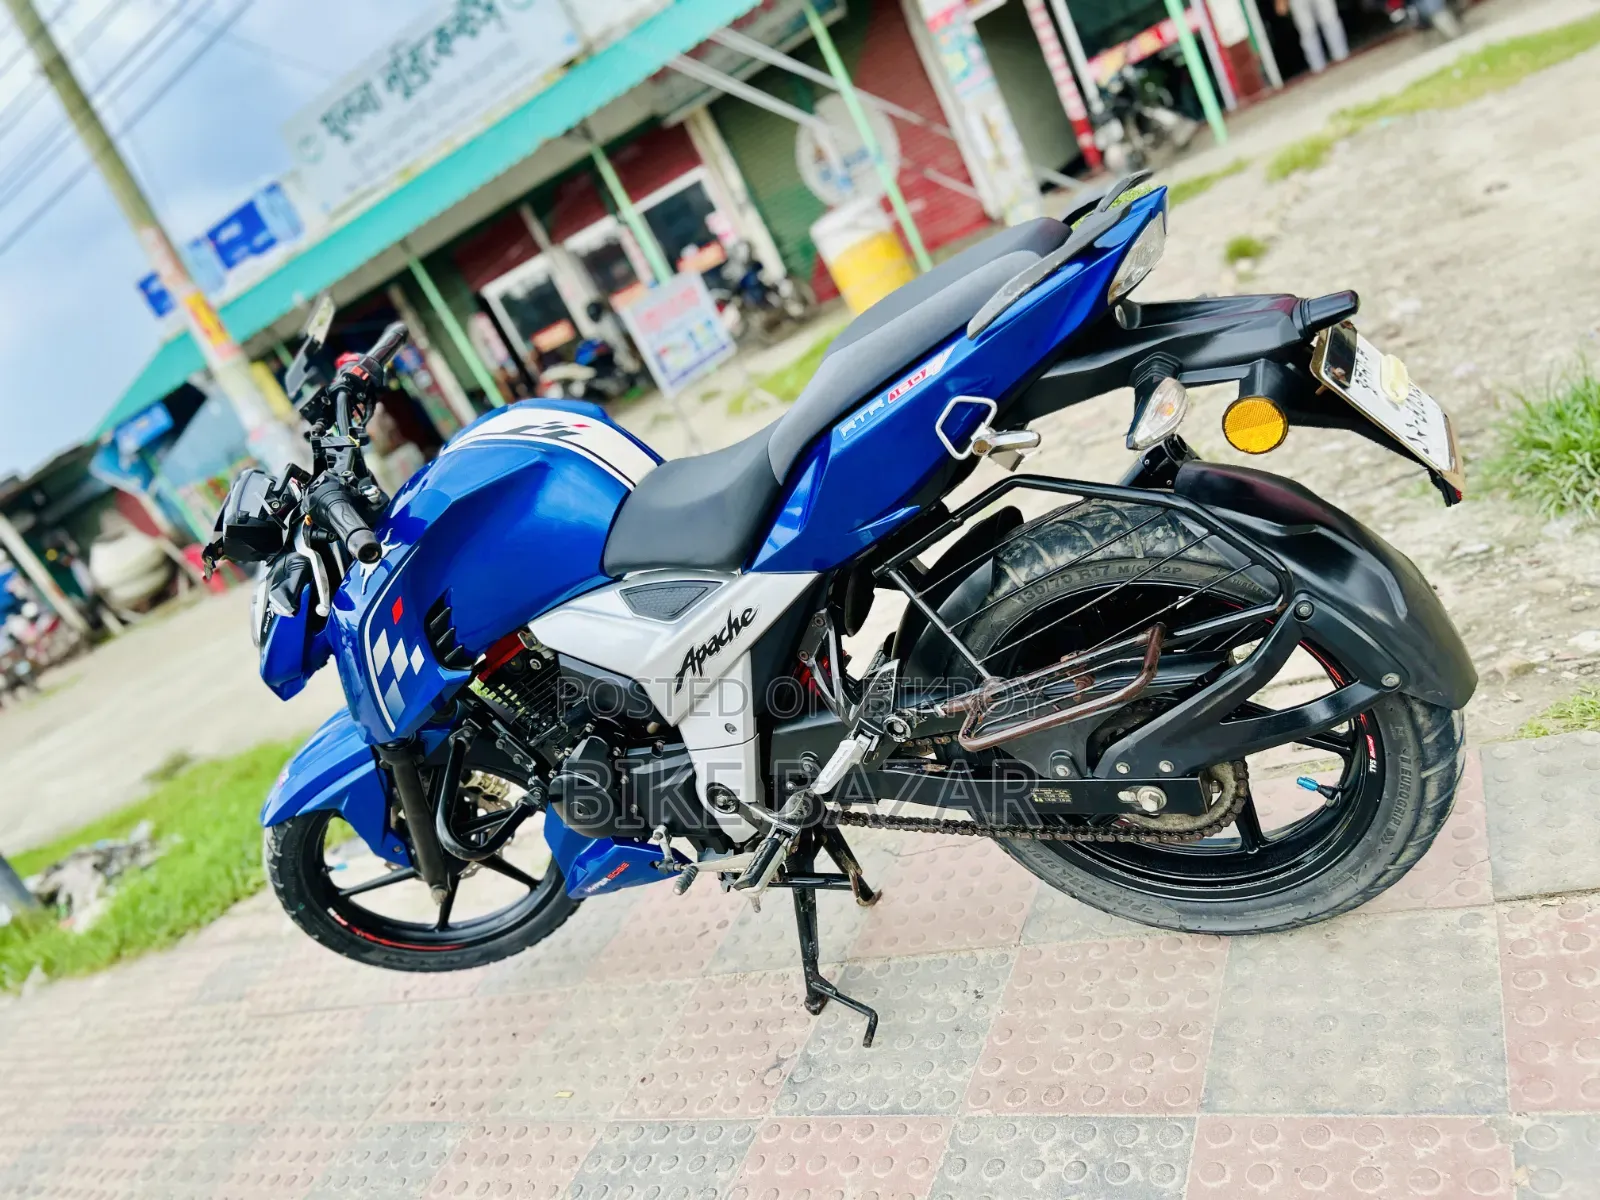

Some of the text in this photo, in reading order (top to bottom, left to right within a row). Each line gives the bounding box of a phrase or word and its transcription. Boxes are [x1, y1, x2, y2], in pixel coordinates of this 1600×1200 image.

[840, 398, 885, 437] RTR
[1016, 575, 1073, 604] 130/70
[1078, 565, 1110, 581] R17
[676, 608, 759, 691] Apache
[1369, 758, 1378, 774] TVS
[1391, 767, 1412, 827] EUROGRIP
